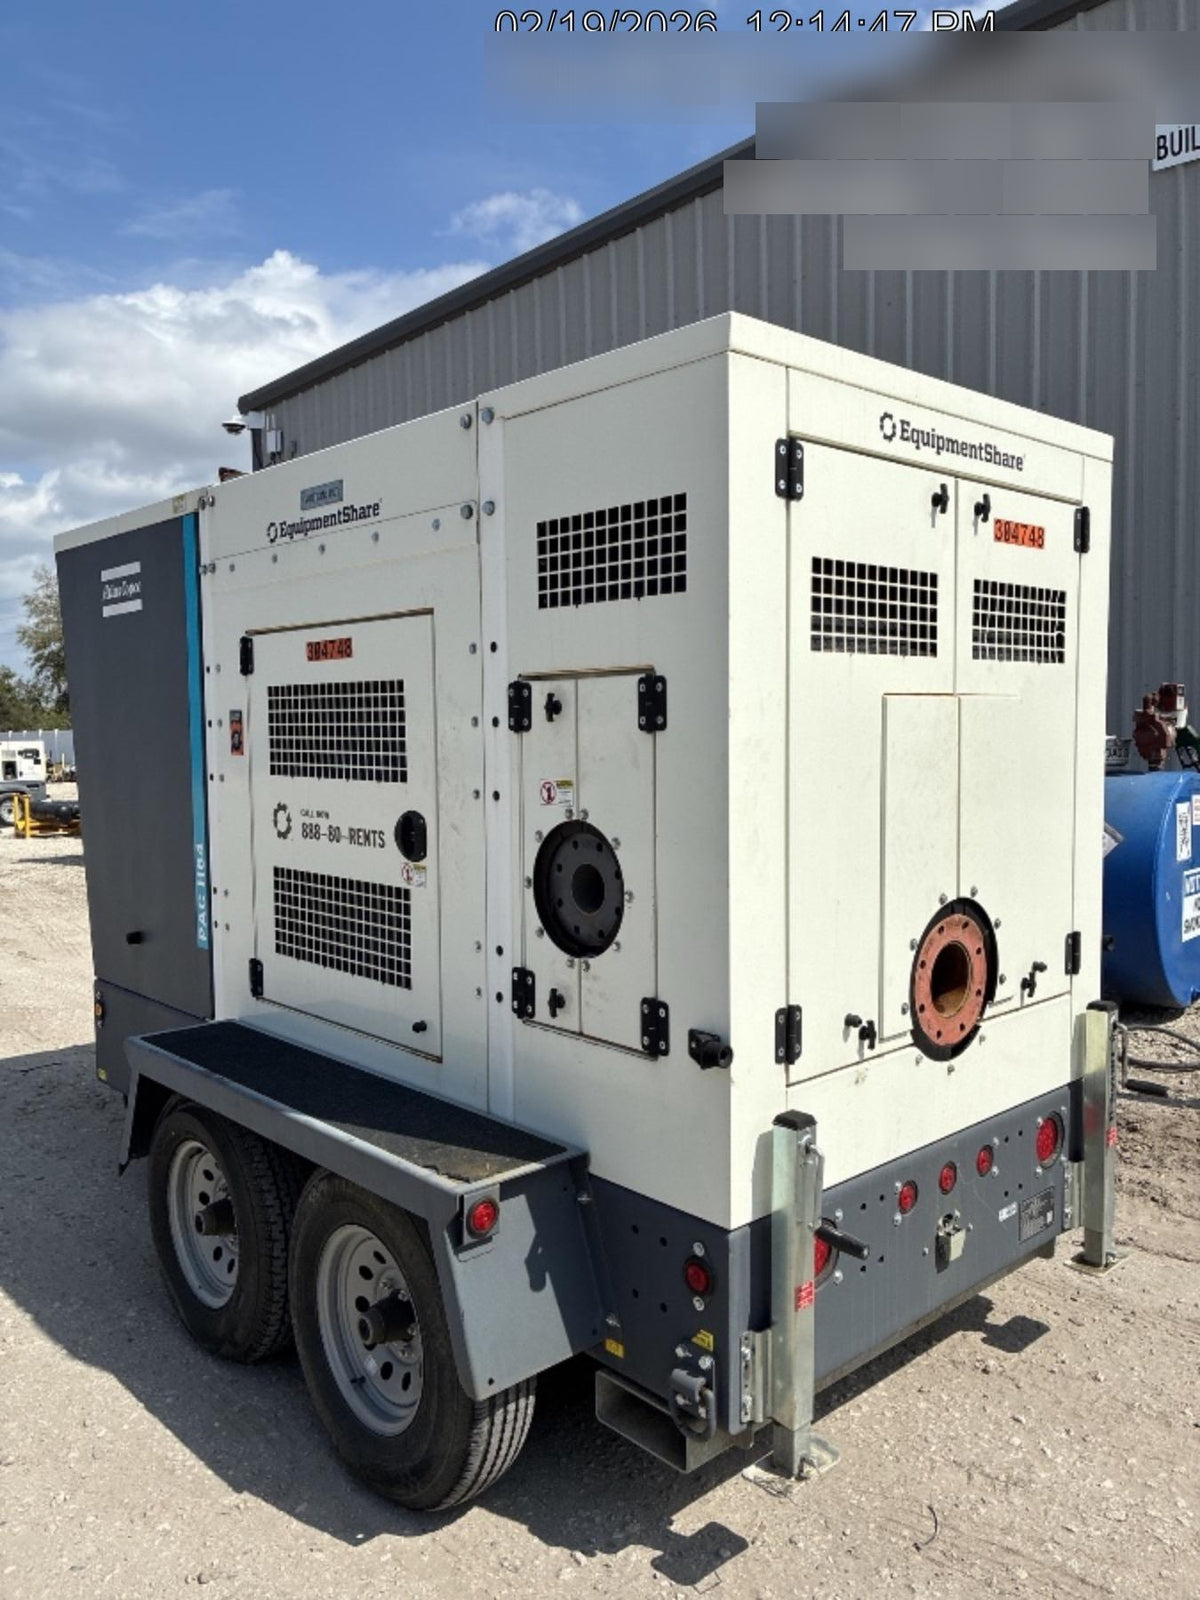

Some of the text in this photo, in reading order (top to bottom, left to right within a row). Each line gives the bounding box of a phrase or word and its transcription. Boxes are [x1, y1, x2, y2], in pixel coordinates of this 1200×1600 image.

[1157, 126, 1200, 160] BUIL
[899, 419, 1024, 471] EquipmentShare
[279, 502, 380, 539] EquipmentShare
[995, 519, 1044, 549] 304748
[306, 638, 352, 661] 304748
